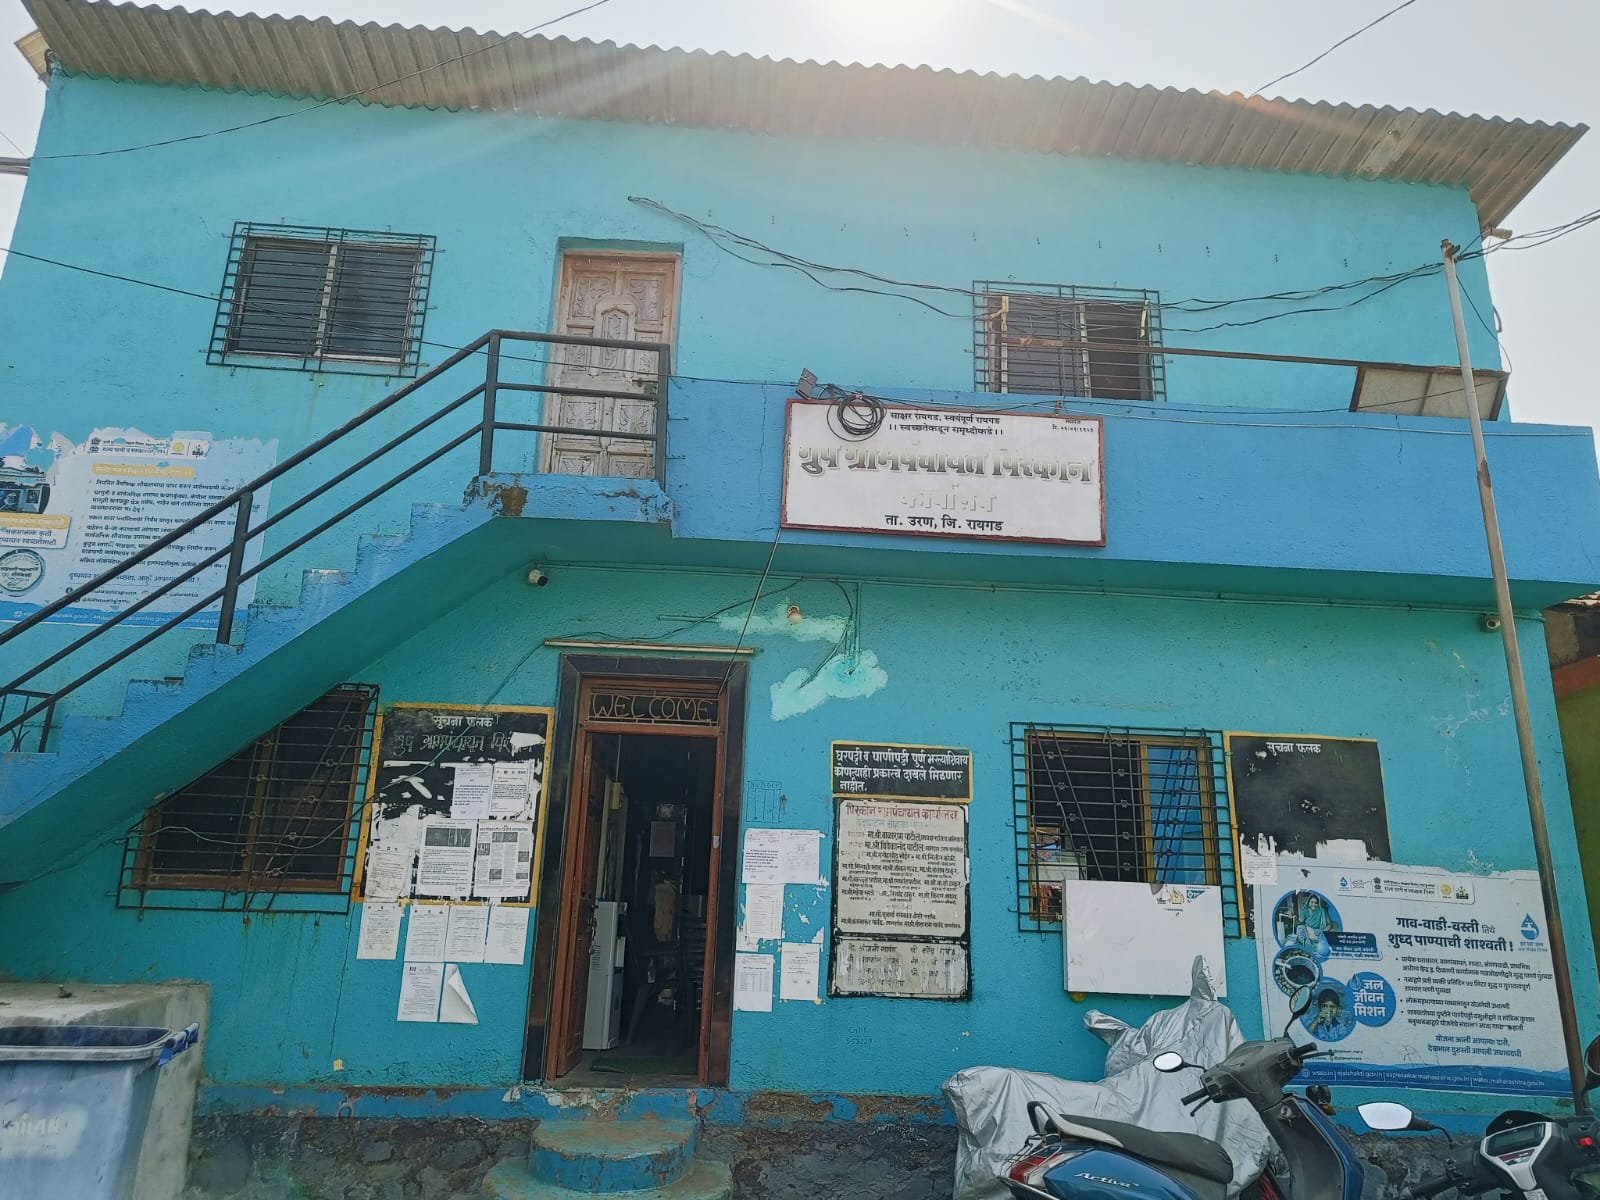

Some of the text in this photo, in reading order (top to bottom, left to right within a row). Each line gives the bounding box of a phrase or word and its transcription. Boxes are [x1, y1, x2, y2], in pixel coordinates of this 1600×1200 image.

[890, 412, 912, 421] साक्षर
[943, 413, 974, 425] स्वयंपूर्ण
[884, 513, 1004, 531] ता. उरण, जि. रायगड
[593, 694, 713, 721] WELCOME
[465, 716, 494, 728] फलक
[836, 747, 862, 765] घरपट्टी
[863, 751, 870, 762] व
[872, 748, 909, 765] पाणीपट्टी
[1295, 743, 1322, 754] फलक
[873, 765, 901, 779] प्रकारचे
[902, 766, 927, 782] दाखले
[846, 802, 876, 816] पिरकोन
[1396, 916, 1479, 933] गाव-वाडी-वस्ती
[1388, 933, 1412, 949] शुध्द
[1414, 933, 1461, 948] पाण्याची
[1464, 937, 1506, 951] शाश्वती
[1362, 980, 1384, 990] जल
[1353, 989, 1384, 1003] जीवन
[1353, 1003, 1386, 1017] मिशन
[1073, 1171, 1133, 1188] Activa
